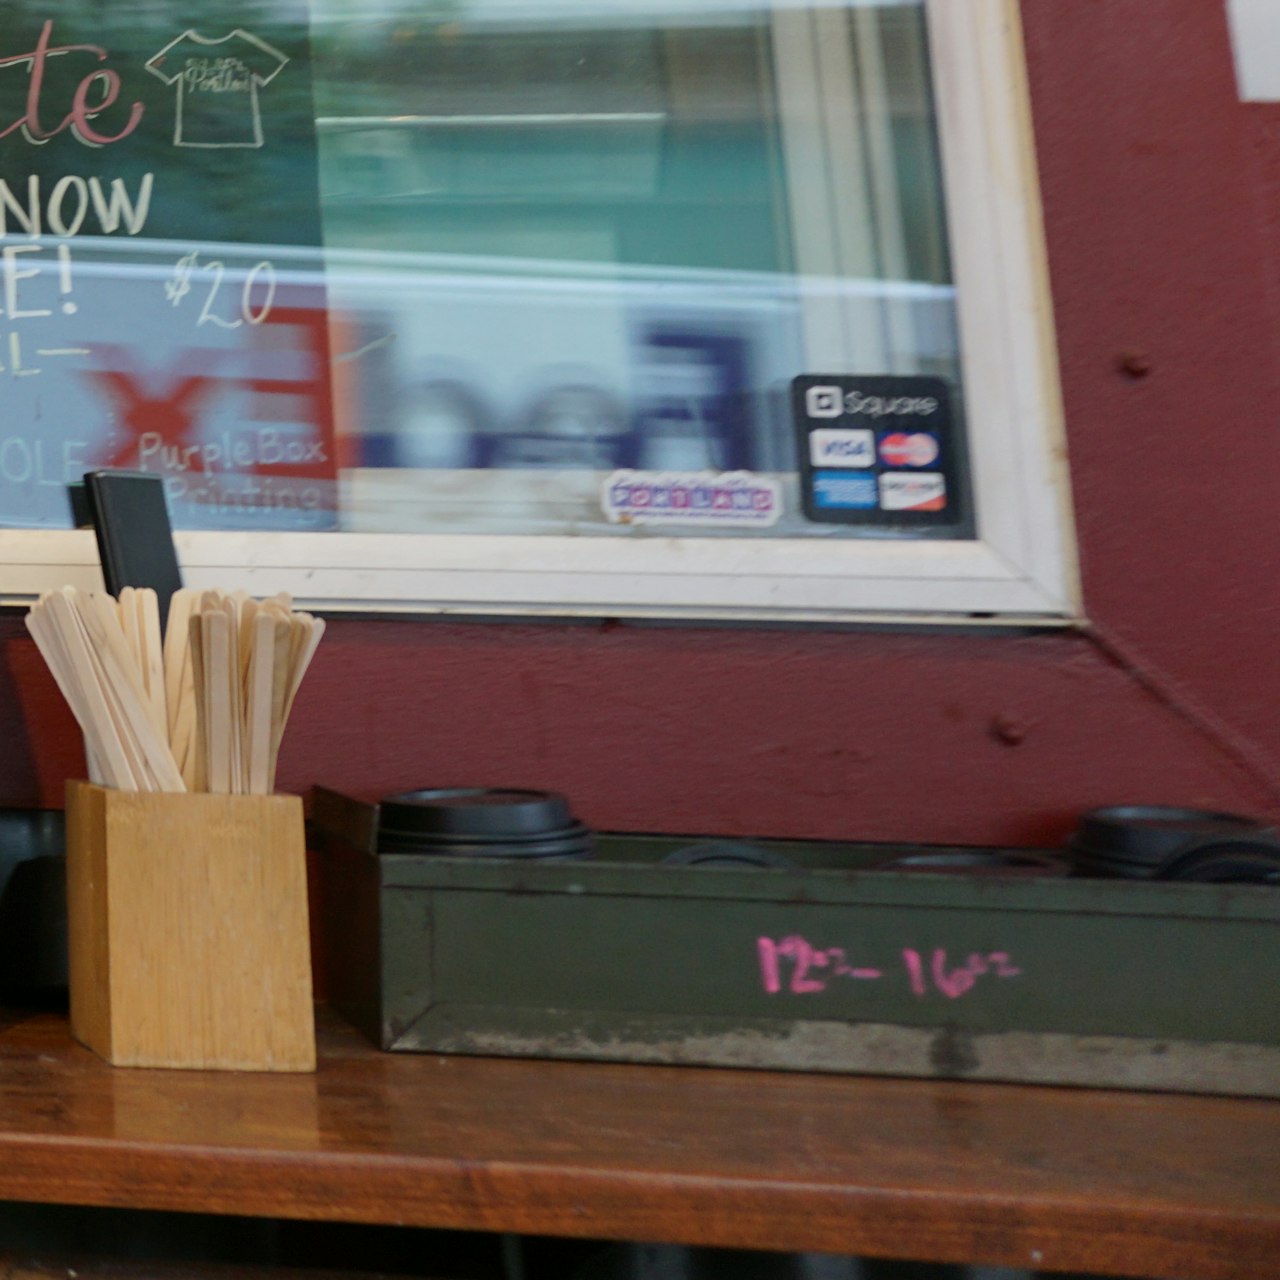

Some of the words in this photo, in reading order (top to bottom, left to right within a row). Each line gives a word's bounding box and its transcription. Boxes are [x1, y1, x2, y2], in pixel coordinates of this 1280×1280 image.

[166, 250, 277, 328] $20
[844, 390, 939, 418] Square
[823, 440, 866, 457] VISA
[166, 475, 321, 524] Printing
[612, 486, 773, 511] PORTLAND
